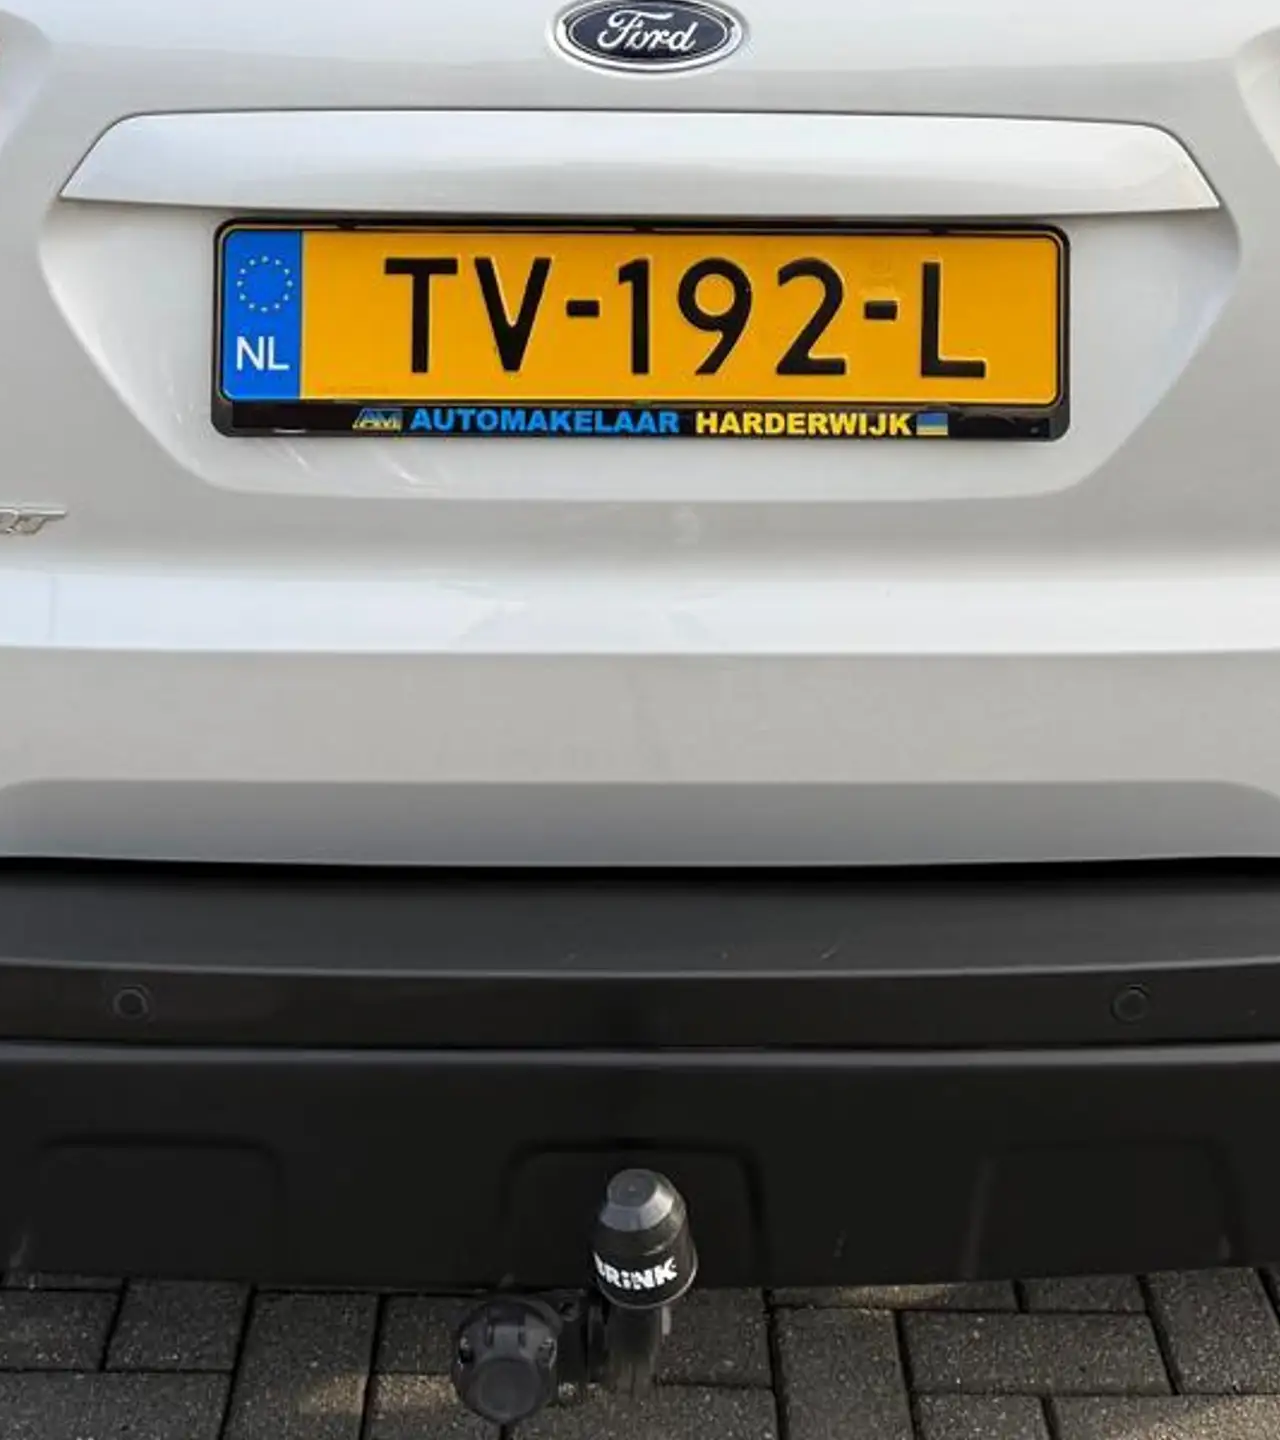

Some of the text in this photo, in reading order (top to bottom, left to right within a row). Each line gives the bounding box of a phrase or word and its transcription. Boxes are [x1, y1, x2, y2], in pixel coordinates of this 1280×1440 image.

[597, 10, 699, 52] Ford
[384, 257, 987, 378] TV-192-L
[237, 336, 289, 371] NL
[409, 408, 680, 434] AUTOMAKELAAR
[695, 411, 912, 437] HARDERWIJK
